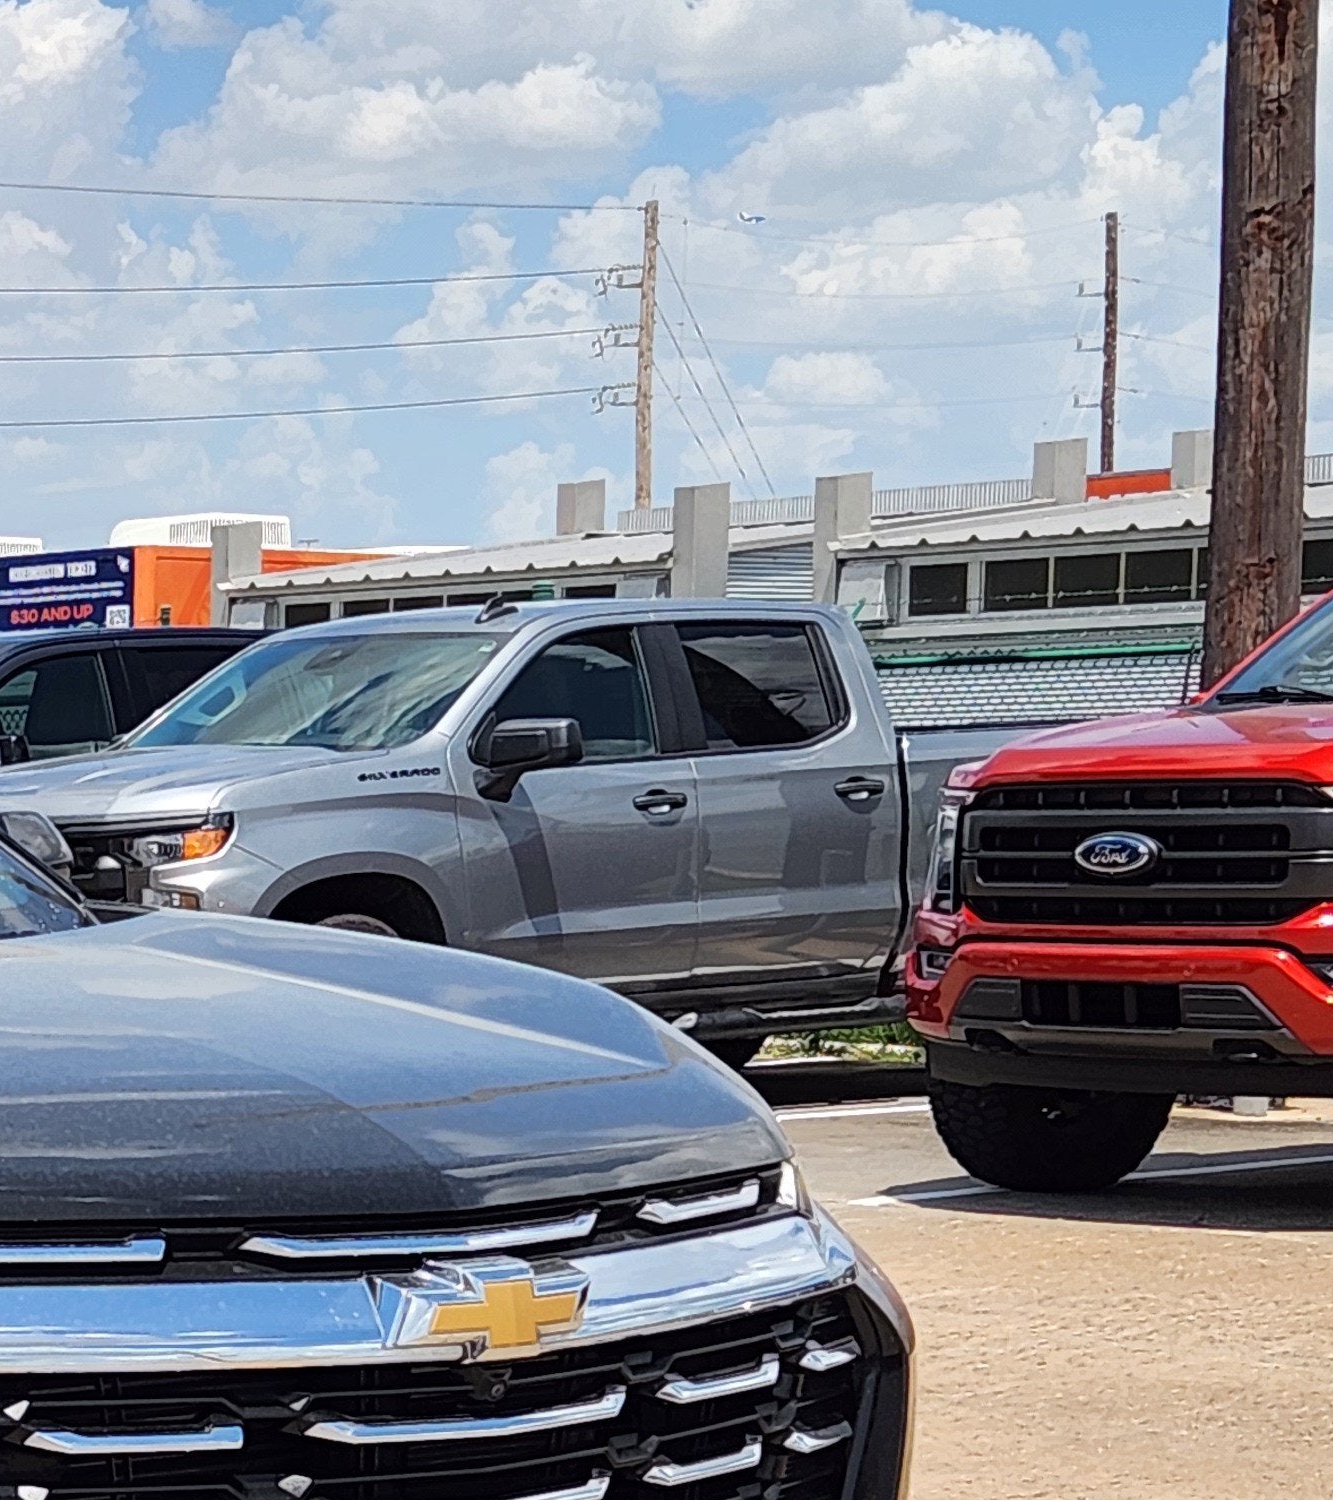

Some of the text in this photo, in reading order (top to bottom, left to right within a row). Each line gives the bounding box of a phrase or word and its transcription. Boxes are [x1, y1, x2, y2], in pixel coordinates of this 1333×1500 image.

[40, 606, 71, 623] AND
[72, 604, 93, 619] UP
[1090, 844, 1131, 864] Ford
